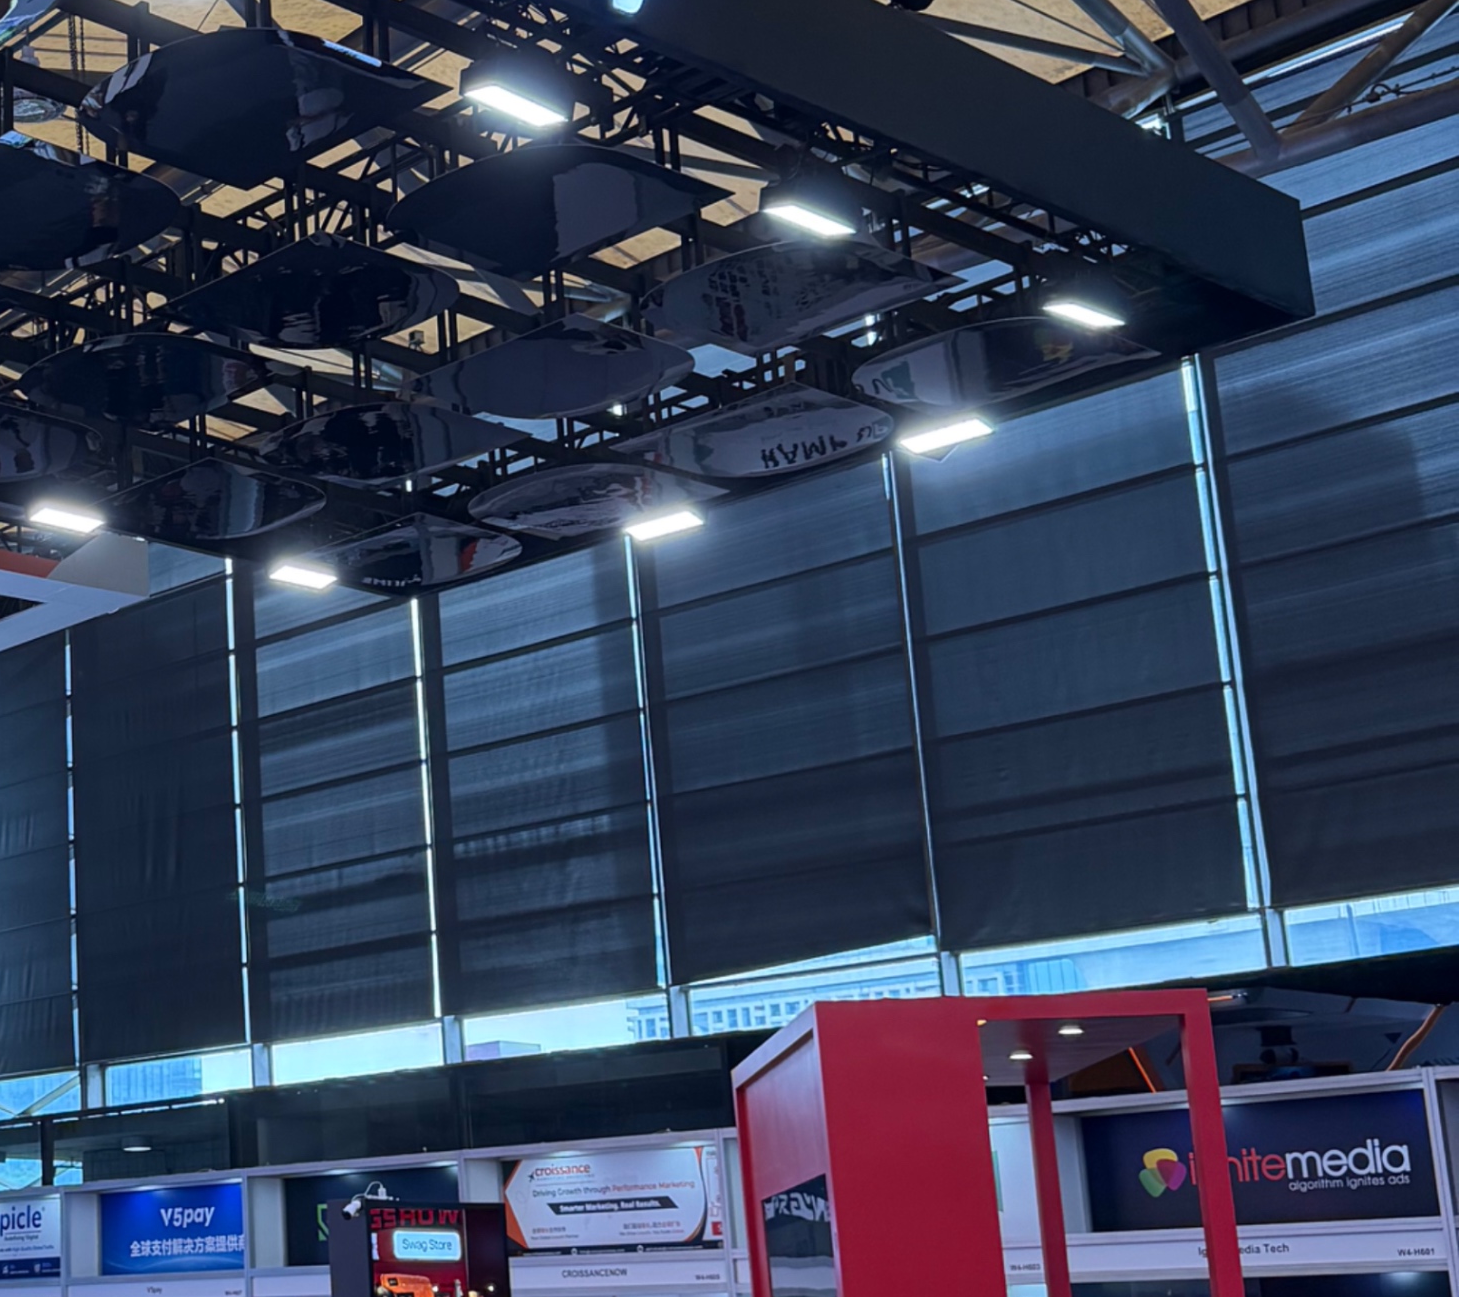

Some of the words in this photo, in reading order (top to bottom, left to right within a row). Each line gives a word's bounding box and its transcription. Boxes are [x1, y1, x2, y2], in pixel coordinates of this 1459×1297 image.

[1189, 1138, 1411, 1185] initemedia
[534, 1162, 591, 1177] croissance
[1288, 1178, 1344, 1193] algorithm
[1346, 1175, 1385, 1191] ignites
[1390, 1173, 1411, 1186] ads
[160, 1206, 215, 1228] V5pay
[402, 1238, 428, 1253] Swag
[429, 1238, 453, 1251] Store
[1238, 1244, 1261, 1255] edia
[1264, 1243, 1290, 1254] Tech
[561, 1268, 628, 1278] CROISSANCENOW
